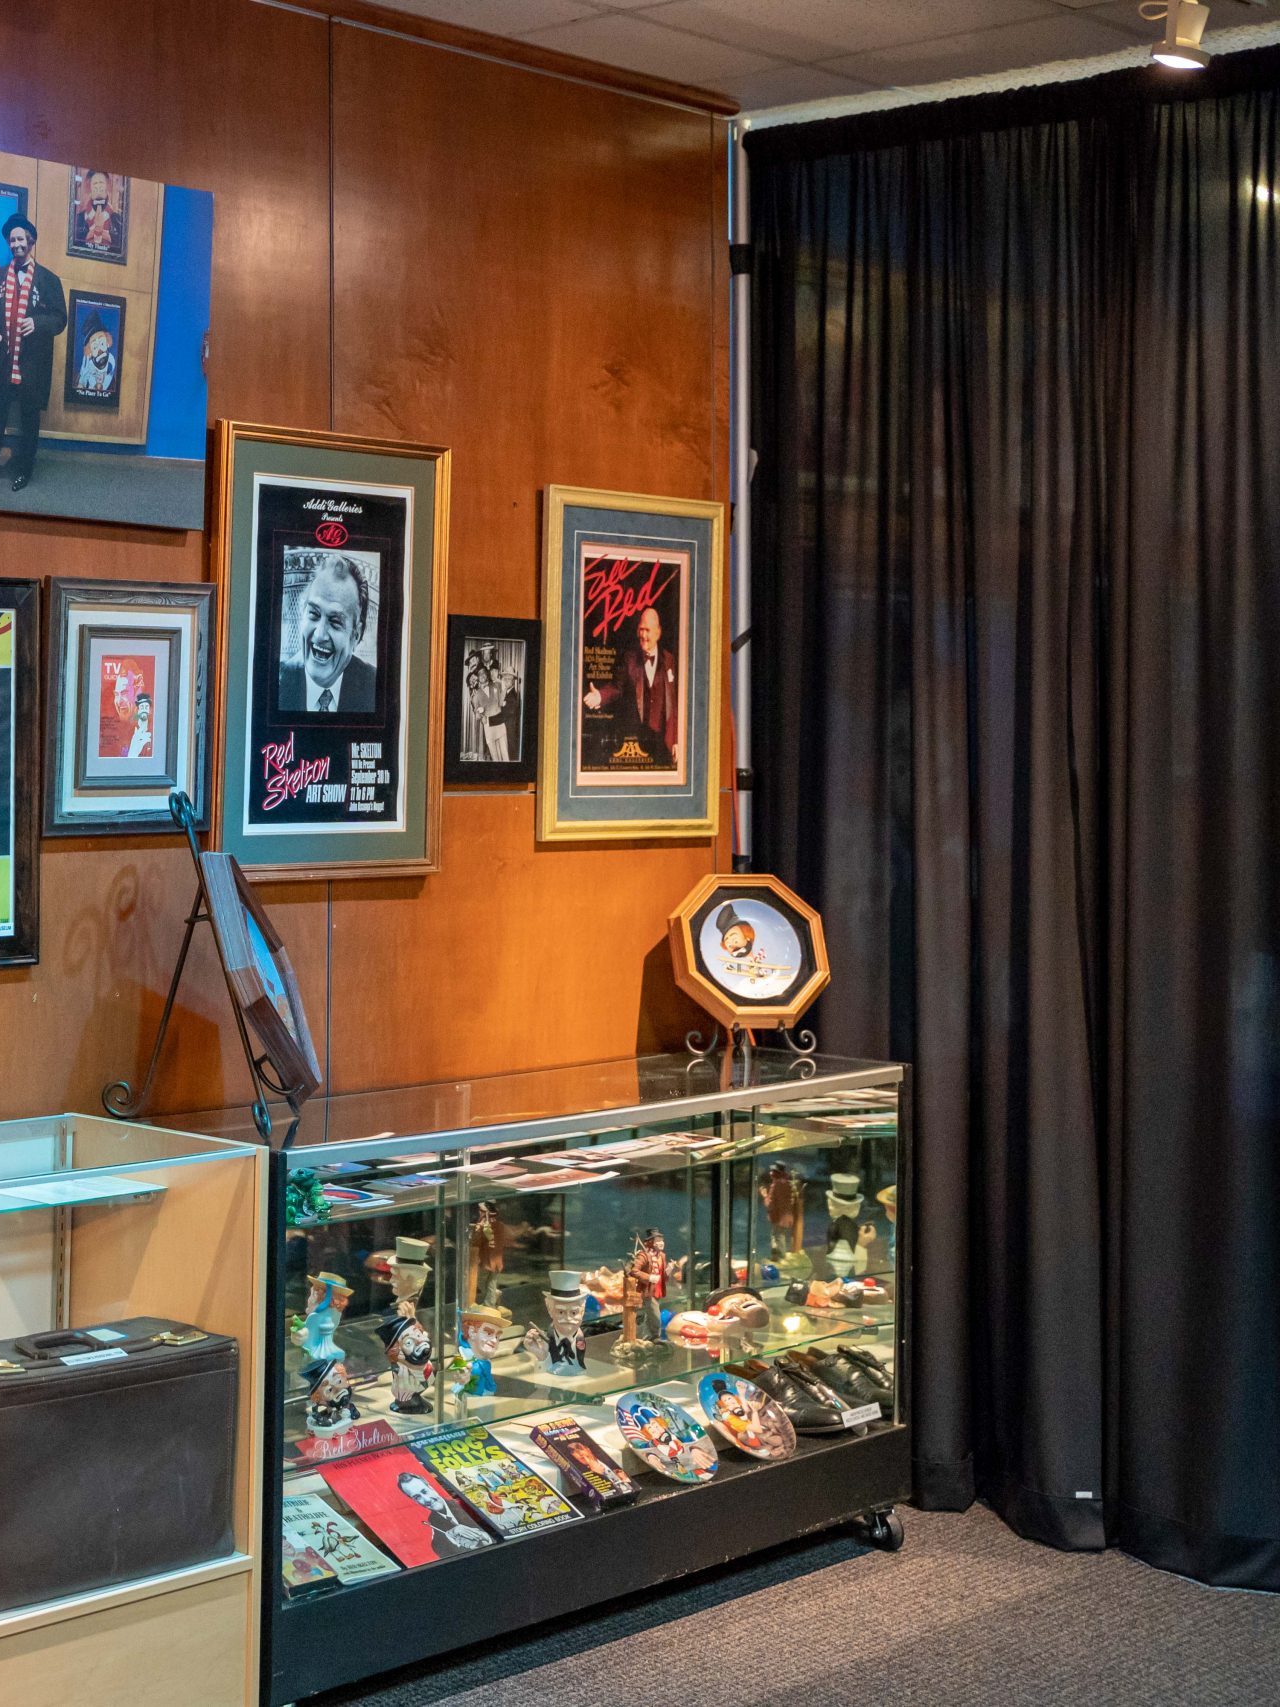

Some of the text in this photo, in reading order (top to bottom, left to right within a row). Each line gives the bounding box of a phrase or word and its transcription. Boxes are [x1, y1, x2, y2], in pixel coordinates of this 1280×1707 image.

[303, 498, 363, 514] Addi Galleries
[321, 512, 343, 522] Presents
[584, 553, 644, 600] See
[584, 560, 679, 644] Red
[104, 662, 121, 675] TV
[261, 731, 294, 780] Red
[360, 742, 382, 759] SKELTON
[262, 755, 330, 811] Skelton
[351, 770, 377, 785] September
[305, 784, 348, 803] ART SHOW
[366, 787, 375, 801] PM
[312, 1438, 345, 1460] Red
[346, 1427, 397, 1450] Skelton
[423, 1437, 483, 1459] FROG
[429, 1445, 507, 1473] FOLLYS
[527, 1518, 556, 1531] COLORING
[556, 1514, 572, 1523] BOOK
